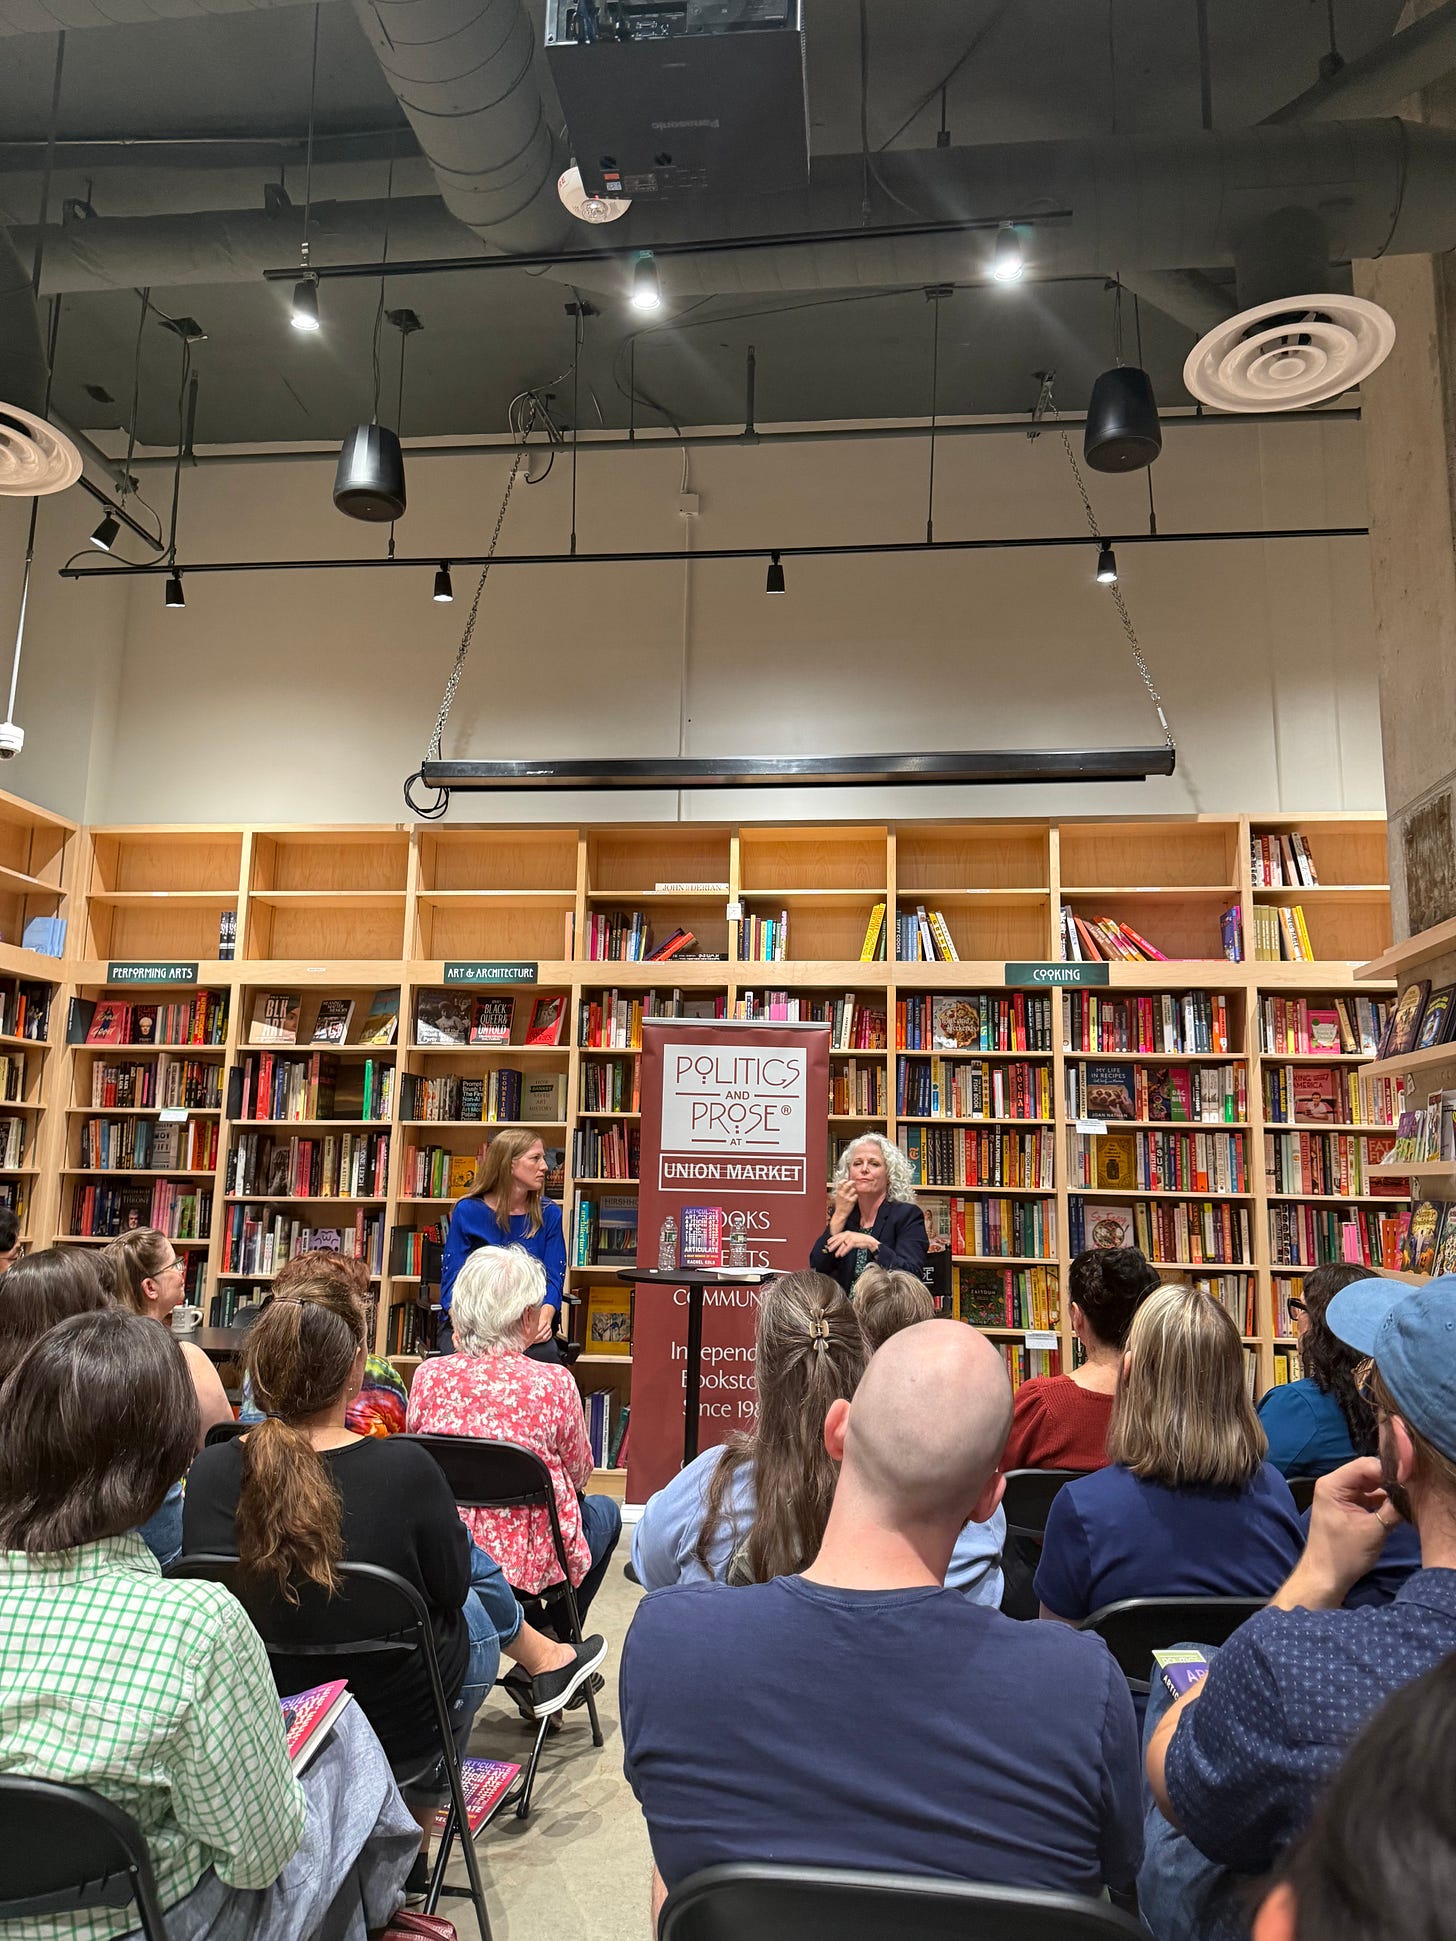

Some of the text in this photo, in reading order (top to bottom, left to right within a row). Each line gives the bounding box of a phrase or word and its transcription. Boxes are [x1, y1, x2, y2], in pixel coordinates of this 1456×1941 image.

[113, 967, 193, 979] PERFORMING ARTS
[447, 968, 534, 979] ART & ARCHITECTURE
[1033, 968, 1081, 981] COOKING
[265, 1000, 289, 1018] BLK
[484, 1003, 507, 1014] BLACK
[478, 1024, 507, 1035] UNTOLD
[676, 1056, 800, 1089] POLITICS
[1294, 1074, 1312, 1082] KING
[725, 1091, 750, 1100] AND
[730, 1138, 743, 1146] AT
[1369, 1141, 1390, 1151] FAT
[664, 1163, 802, 1181] UNION MARKET
[721, 1211, 770, 1229] OKS
[673, 1289, 761, 1307] CMMUN
[1163, 1675, 1179, 1700] ARTIC
